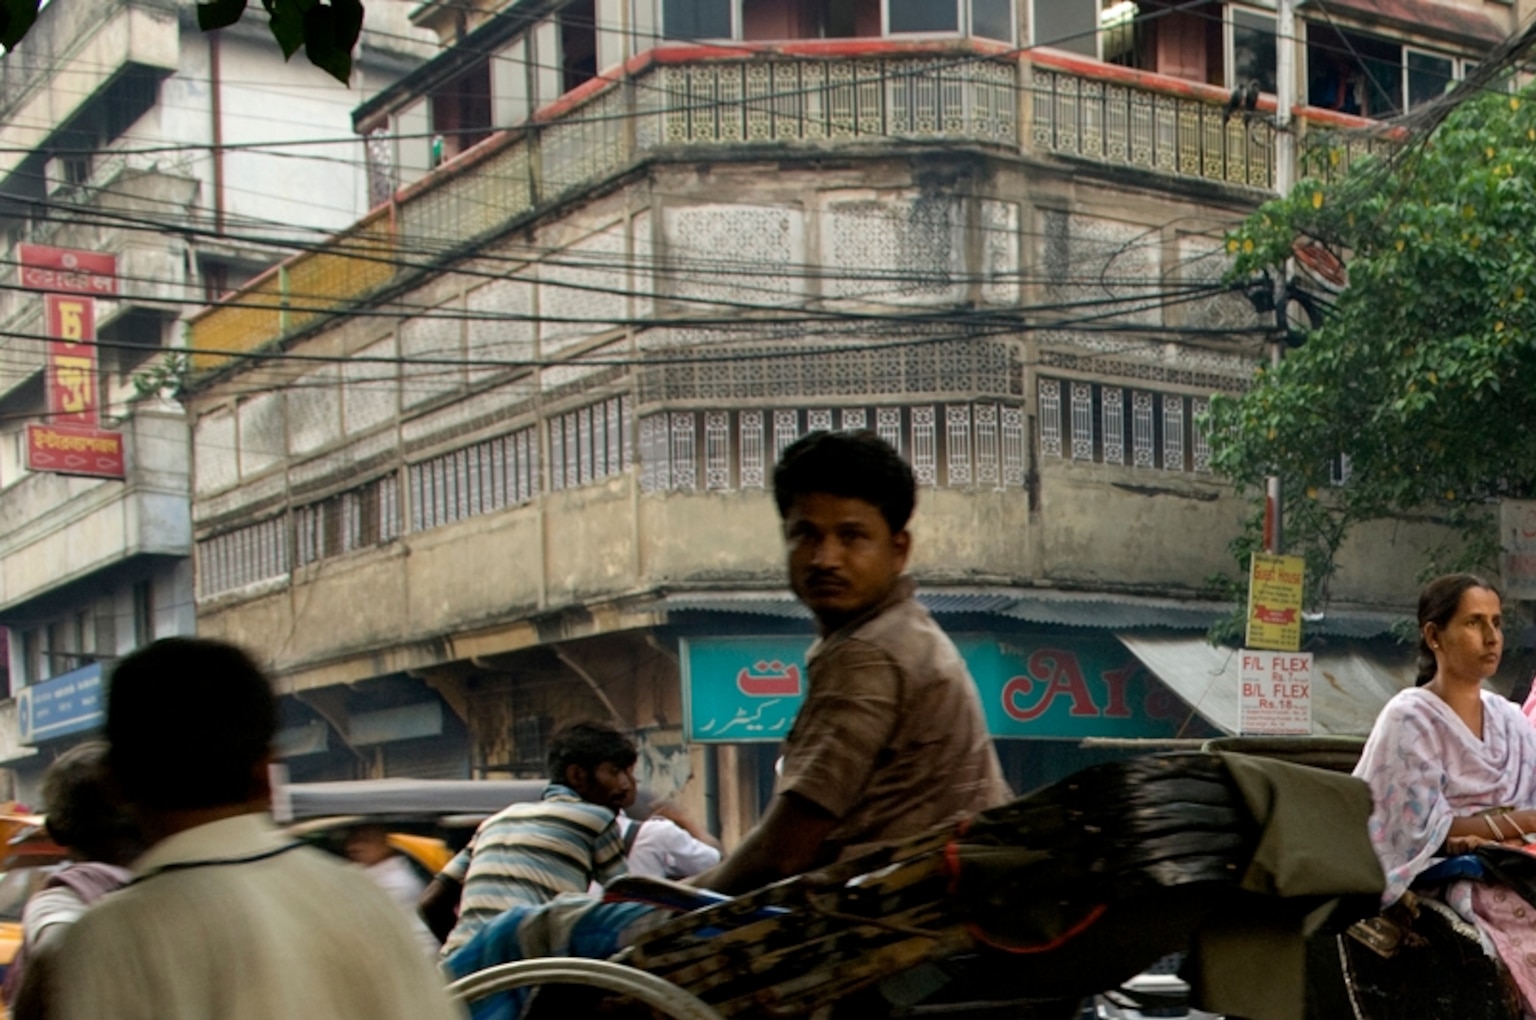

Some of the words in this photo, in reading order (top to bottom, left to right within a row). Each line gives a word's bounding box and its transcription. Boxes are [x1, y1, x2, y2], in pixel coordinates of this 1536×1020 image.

[1243, 656, 1264, 671] F/L
[1272, 657, 1309, 672] FLEX
[1243, 682, 1266, 698] B/L
[1273, 684, 1310, 699] FLEX
